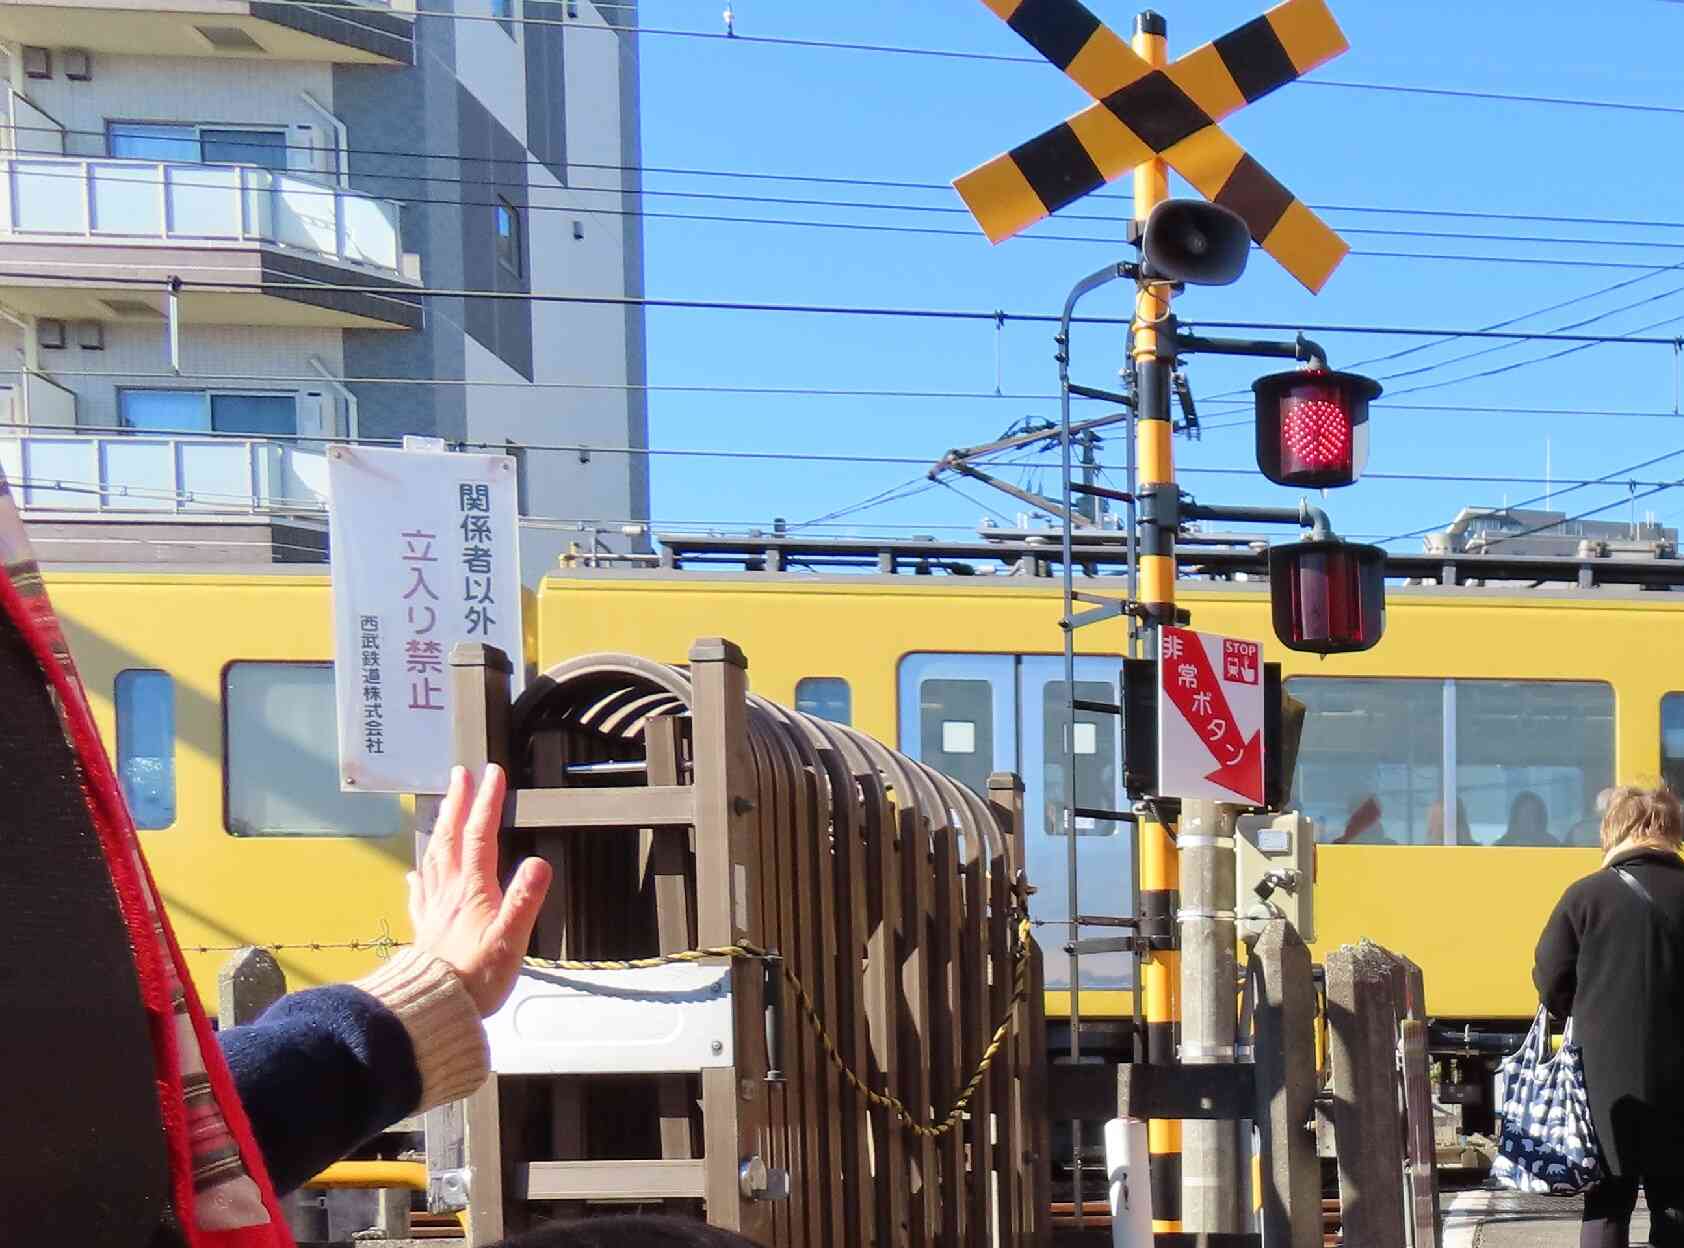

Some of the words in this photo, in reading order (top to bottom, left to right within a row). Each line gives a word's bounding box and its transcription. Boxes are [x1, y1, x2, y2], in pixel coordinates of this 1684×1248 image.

[402, 529, 445, 711] 立入り禁止
[460, 483, 497, 635] 関係者以外
[360, 614, 385, 755] 西武鉄道株式会社
[1163, 635, 1244, 766] 非常ボタン
[1225, 641, 1257, 657] STOP
